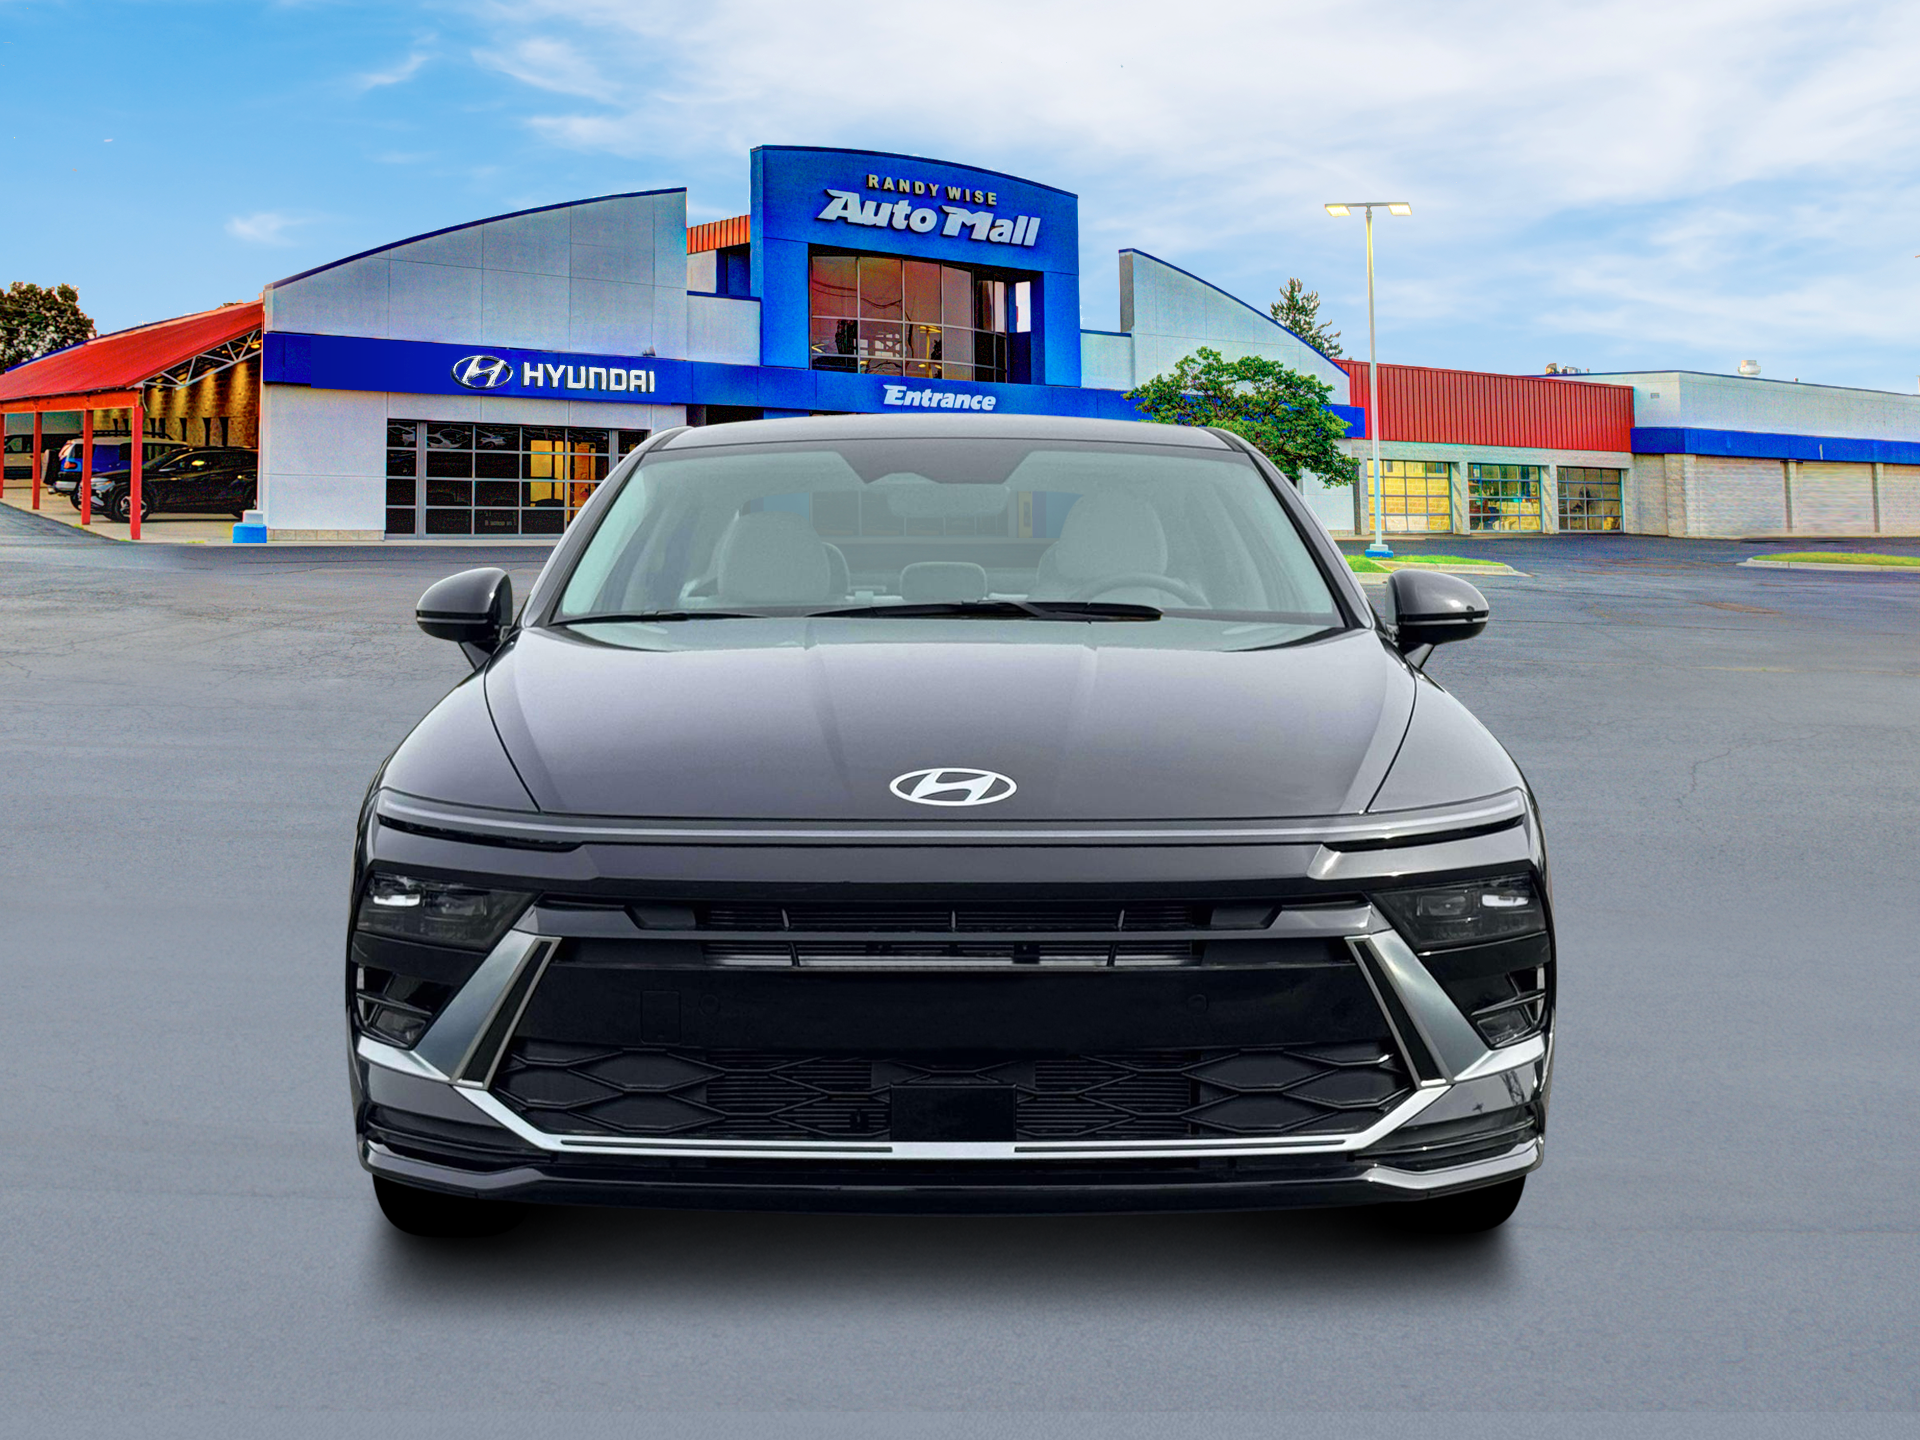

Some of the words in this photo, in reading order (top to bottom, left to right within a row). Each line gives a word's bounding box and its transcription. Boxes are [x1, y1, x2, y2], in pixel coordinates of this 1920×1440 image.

[867, 174, 939, 197] RANDY
[946, 186, 997, 205] WISE
[817, 188, 938, 233] Auto
[940, 205, 1041, 246] Mall
[522, 362, 655, 392] HYUNDAI
[883, 384, 996, 411] Entrance
